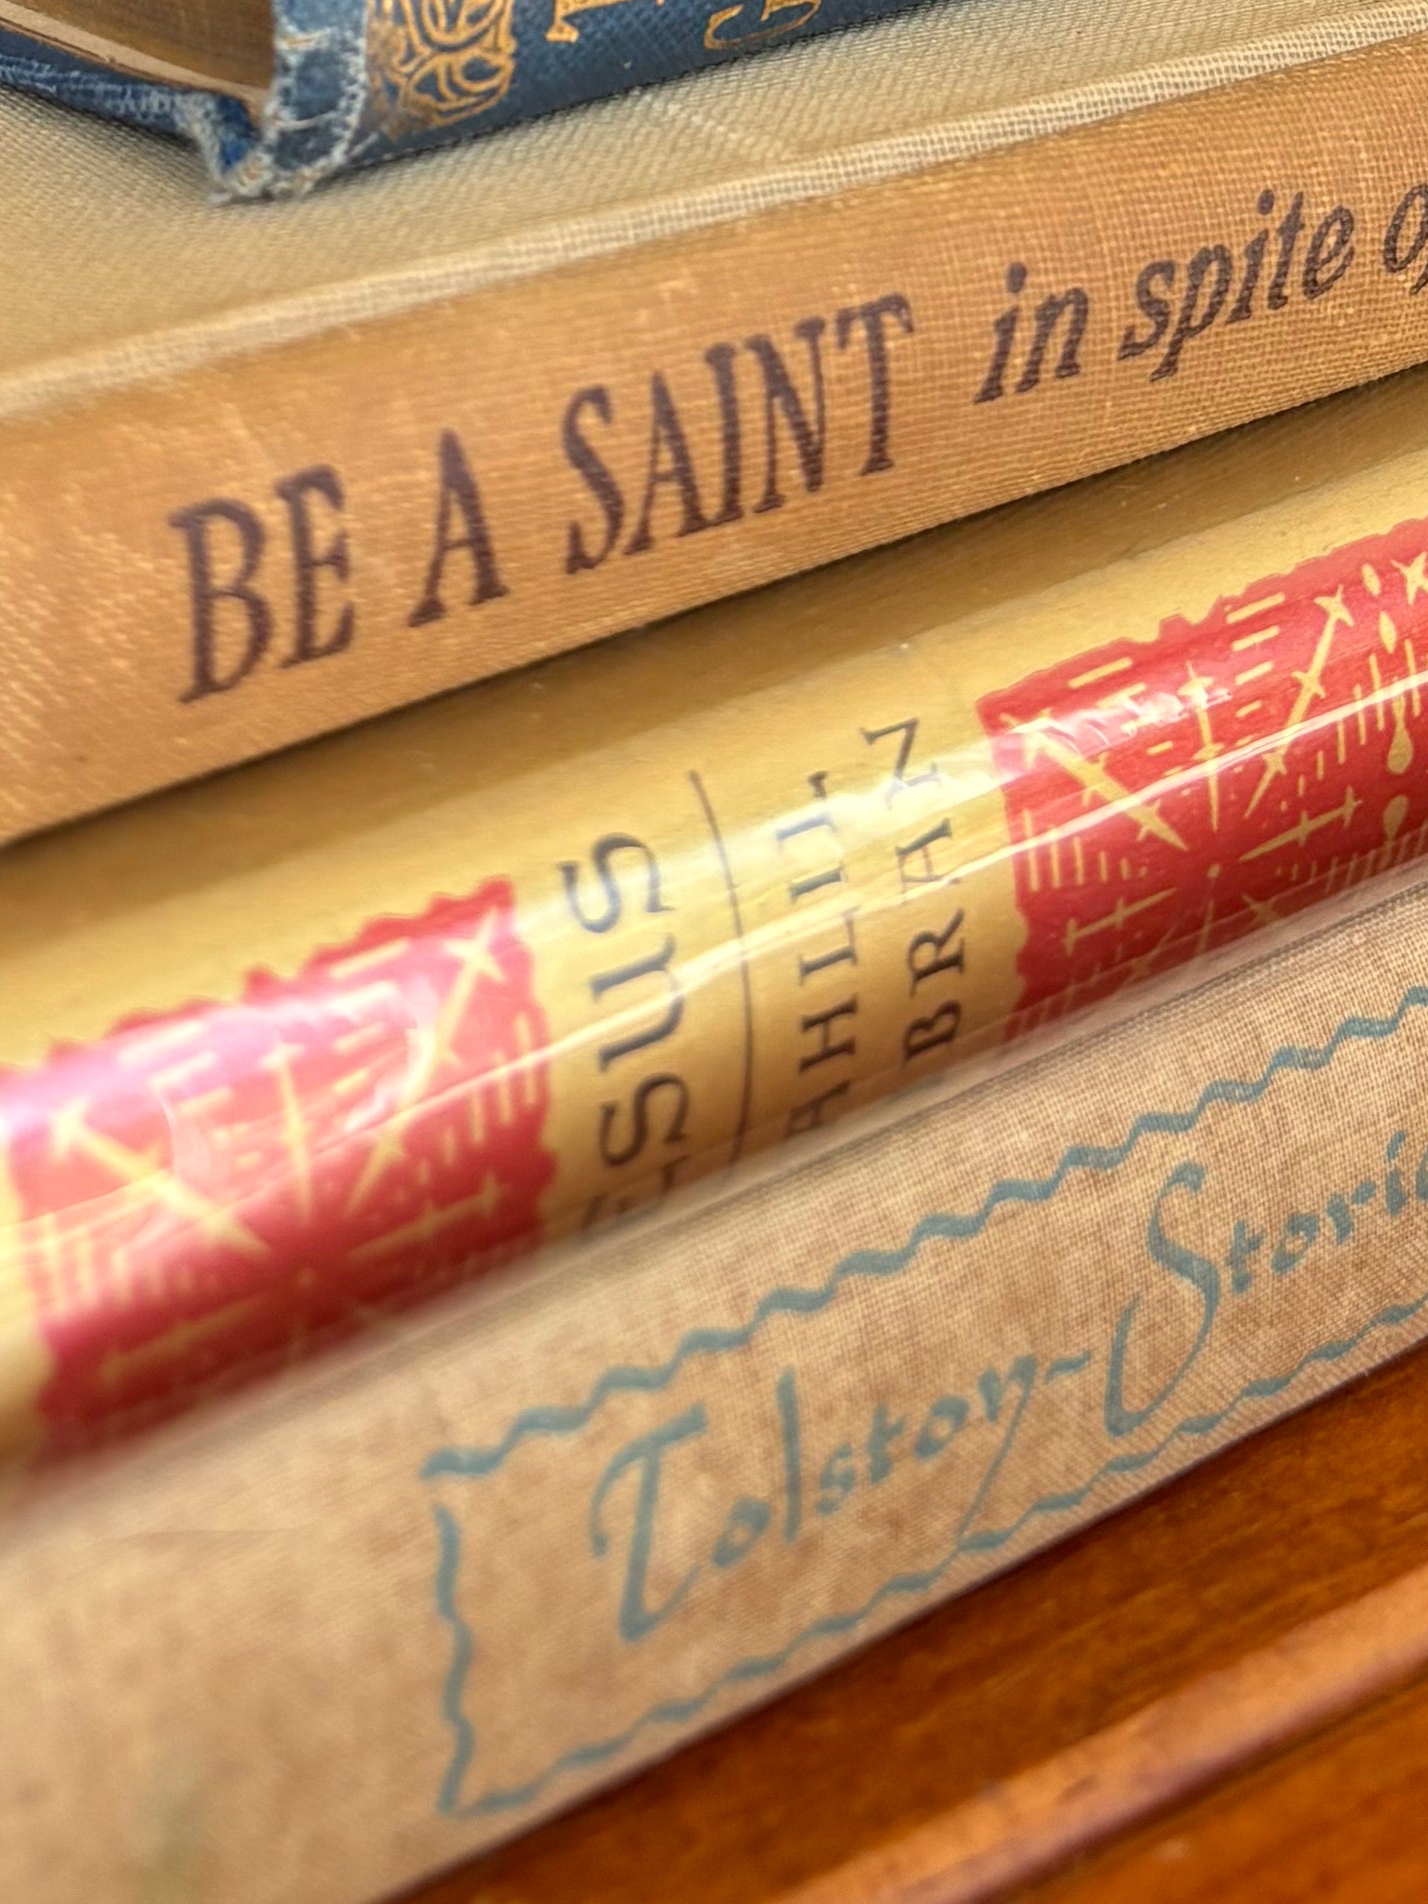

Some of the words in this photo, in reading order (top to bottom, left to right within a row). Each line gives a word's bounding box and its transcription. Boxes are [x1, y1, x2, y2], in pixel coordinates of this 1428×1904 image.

[167, 464, 355, 703] BE
[408, 429, 510, 627] A
[562, 292, 914, 576] SAINT
[973, 260, 1094, 405] in
[1115, 190, 1357, 383] spite
[774, 770, 864, 1140] AHLIL
